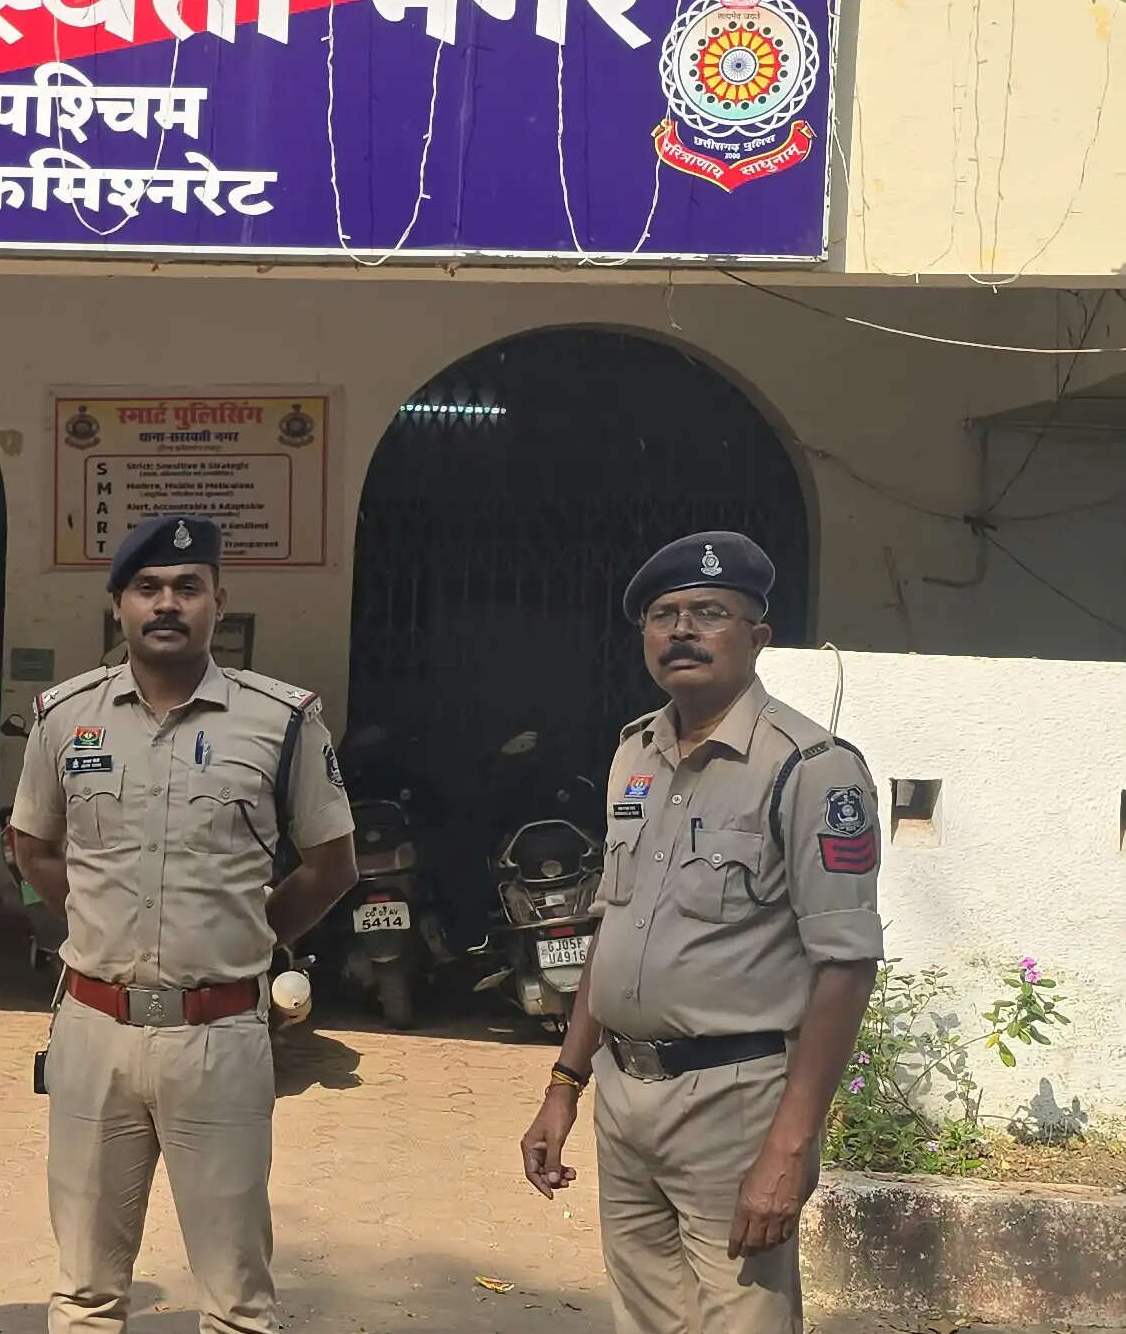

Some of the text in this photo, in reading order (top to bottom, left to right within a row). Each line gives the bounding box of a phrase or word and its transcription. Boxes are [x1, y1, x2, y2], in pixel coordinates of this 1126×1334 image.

[117, 401, 263, 430] स्मार्ट पुलिसिंग
[97, 462, 108, 475] S
[96, 482, 112, 495] M
[96, 502, 109, 515] A
[96, 521, 108, 534] R
[96, 540, 107, 554] T
[362, 916, 403, 930] 5414
